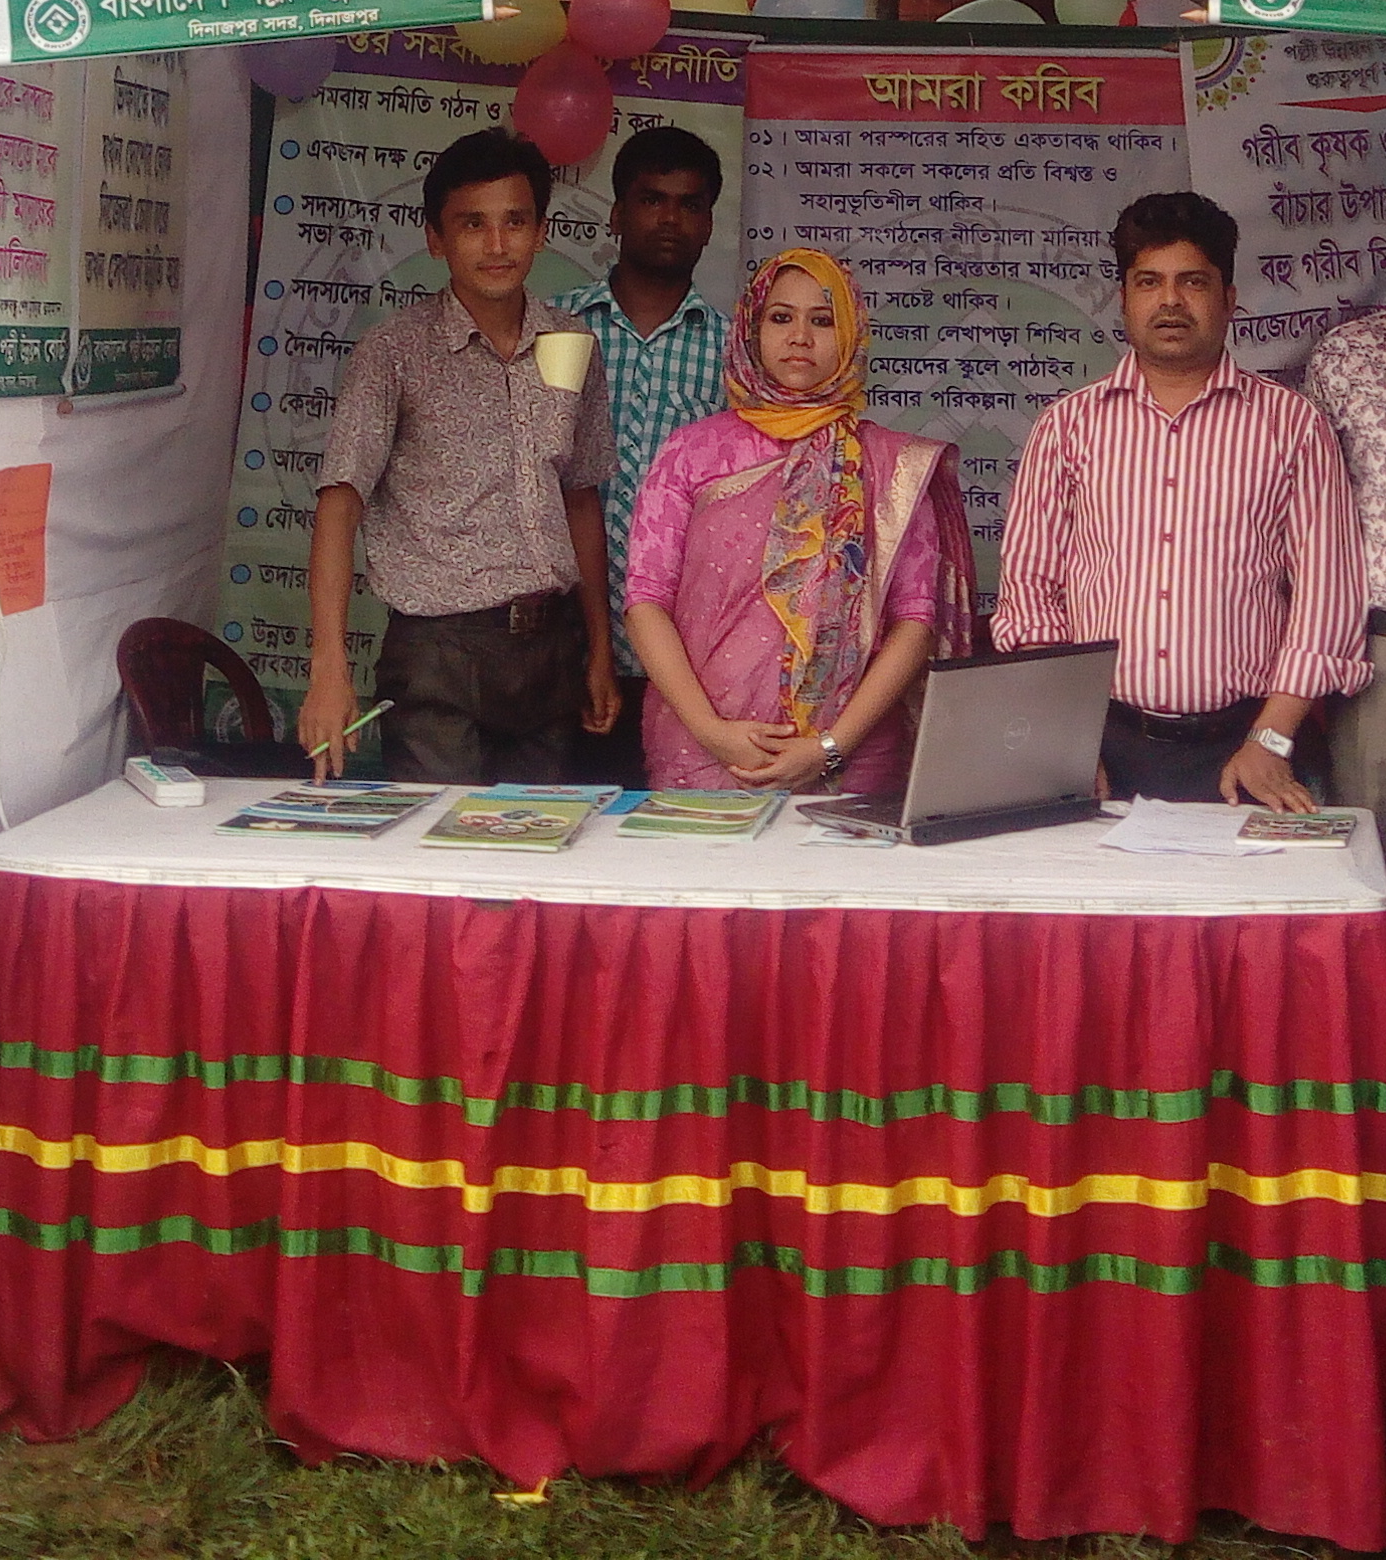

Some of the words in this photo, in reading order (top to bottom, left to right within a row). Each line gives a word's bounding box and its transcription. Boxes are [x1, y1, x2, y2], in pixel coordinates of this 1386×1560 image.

[187, 17, 258, 39] দিনাজপুর
[264, 14, 304, 32] সদর,
[309, 8, 380, 28] দিনাজপুর
[863, 69, 987, 112] আমরা
[997, 62, 1105, 114] করিব
[376, 84, 434, 115] সমিতি
[439, 89, 480, 121] গঠন
[486, 103, 501, 121] ও
[795, 129, 852, 147] আমরা
[859, 130, 949, 147] পরস্পরের
[956, 127, 1006, 149] সহিত
[1015, 131, 1100, 151] একতাবদ্ধ
[1242, 123, 1301, 167] গরীব
[1307, 129, 1370, 176] কৃষক
[306, 139, 366, 168] একজন
[374, 145, 407, 168] দক্ষ
[795, 161, 851, 178] আমরা
[860, 163, 915, 179] সকলে
[923, 163, 990, 181] সকলের
[998, 159, 1037, 181] প্রতি
[1103, 167, 1117, 181] ও
[301, 194, 382, 226] সদস্যদের
[800, 188, 921, 217] সহানুভূতিশীল
[1268, 182, 1332, 226] বাঁচার
[299, 222, 335, 247] সভা
[794, 225, 852, 243] আমরা
[859, 221, 944, 245] সংগঠনের
[951, 222, 1034, 247] নীতিমালা
[1042, 225, 1101, 247] মানিয়া
[859, 258, 925, 278] পরস্পর
[1028, 261, 1091, 280] মাধ্যমে
[1258, 254, 1298, 292] বহু
[1301, 238, 1361, 282] গরীব
[291, 279, 374, 306] সদস্যদের
[886, 291, 933, 310] সচেষ্ট
[937, 326, 1020, 348] লেখাপড়া
[1026, 321, 1081, 345] শিখিব
[1091, 329, 1105, 344] ও
[1230, 303, 1332, 346] নিজেদের
[869, 357, 949, 376] মেয়েদের
[956, 357, 999, 379] স্কুলে
[930, 387, 1016, 411] পরিকল্পনা
